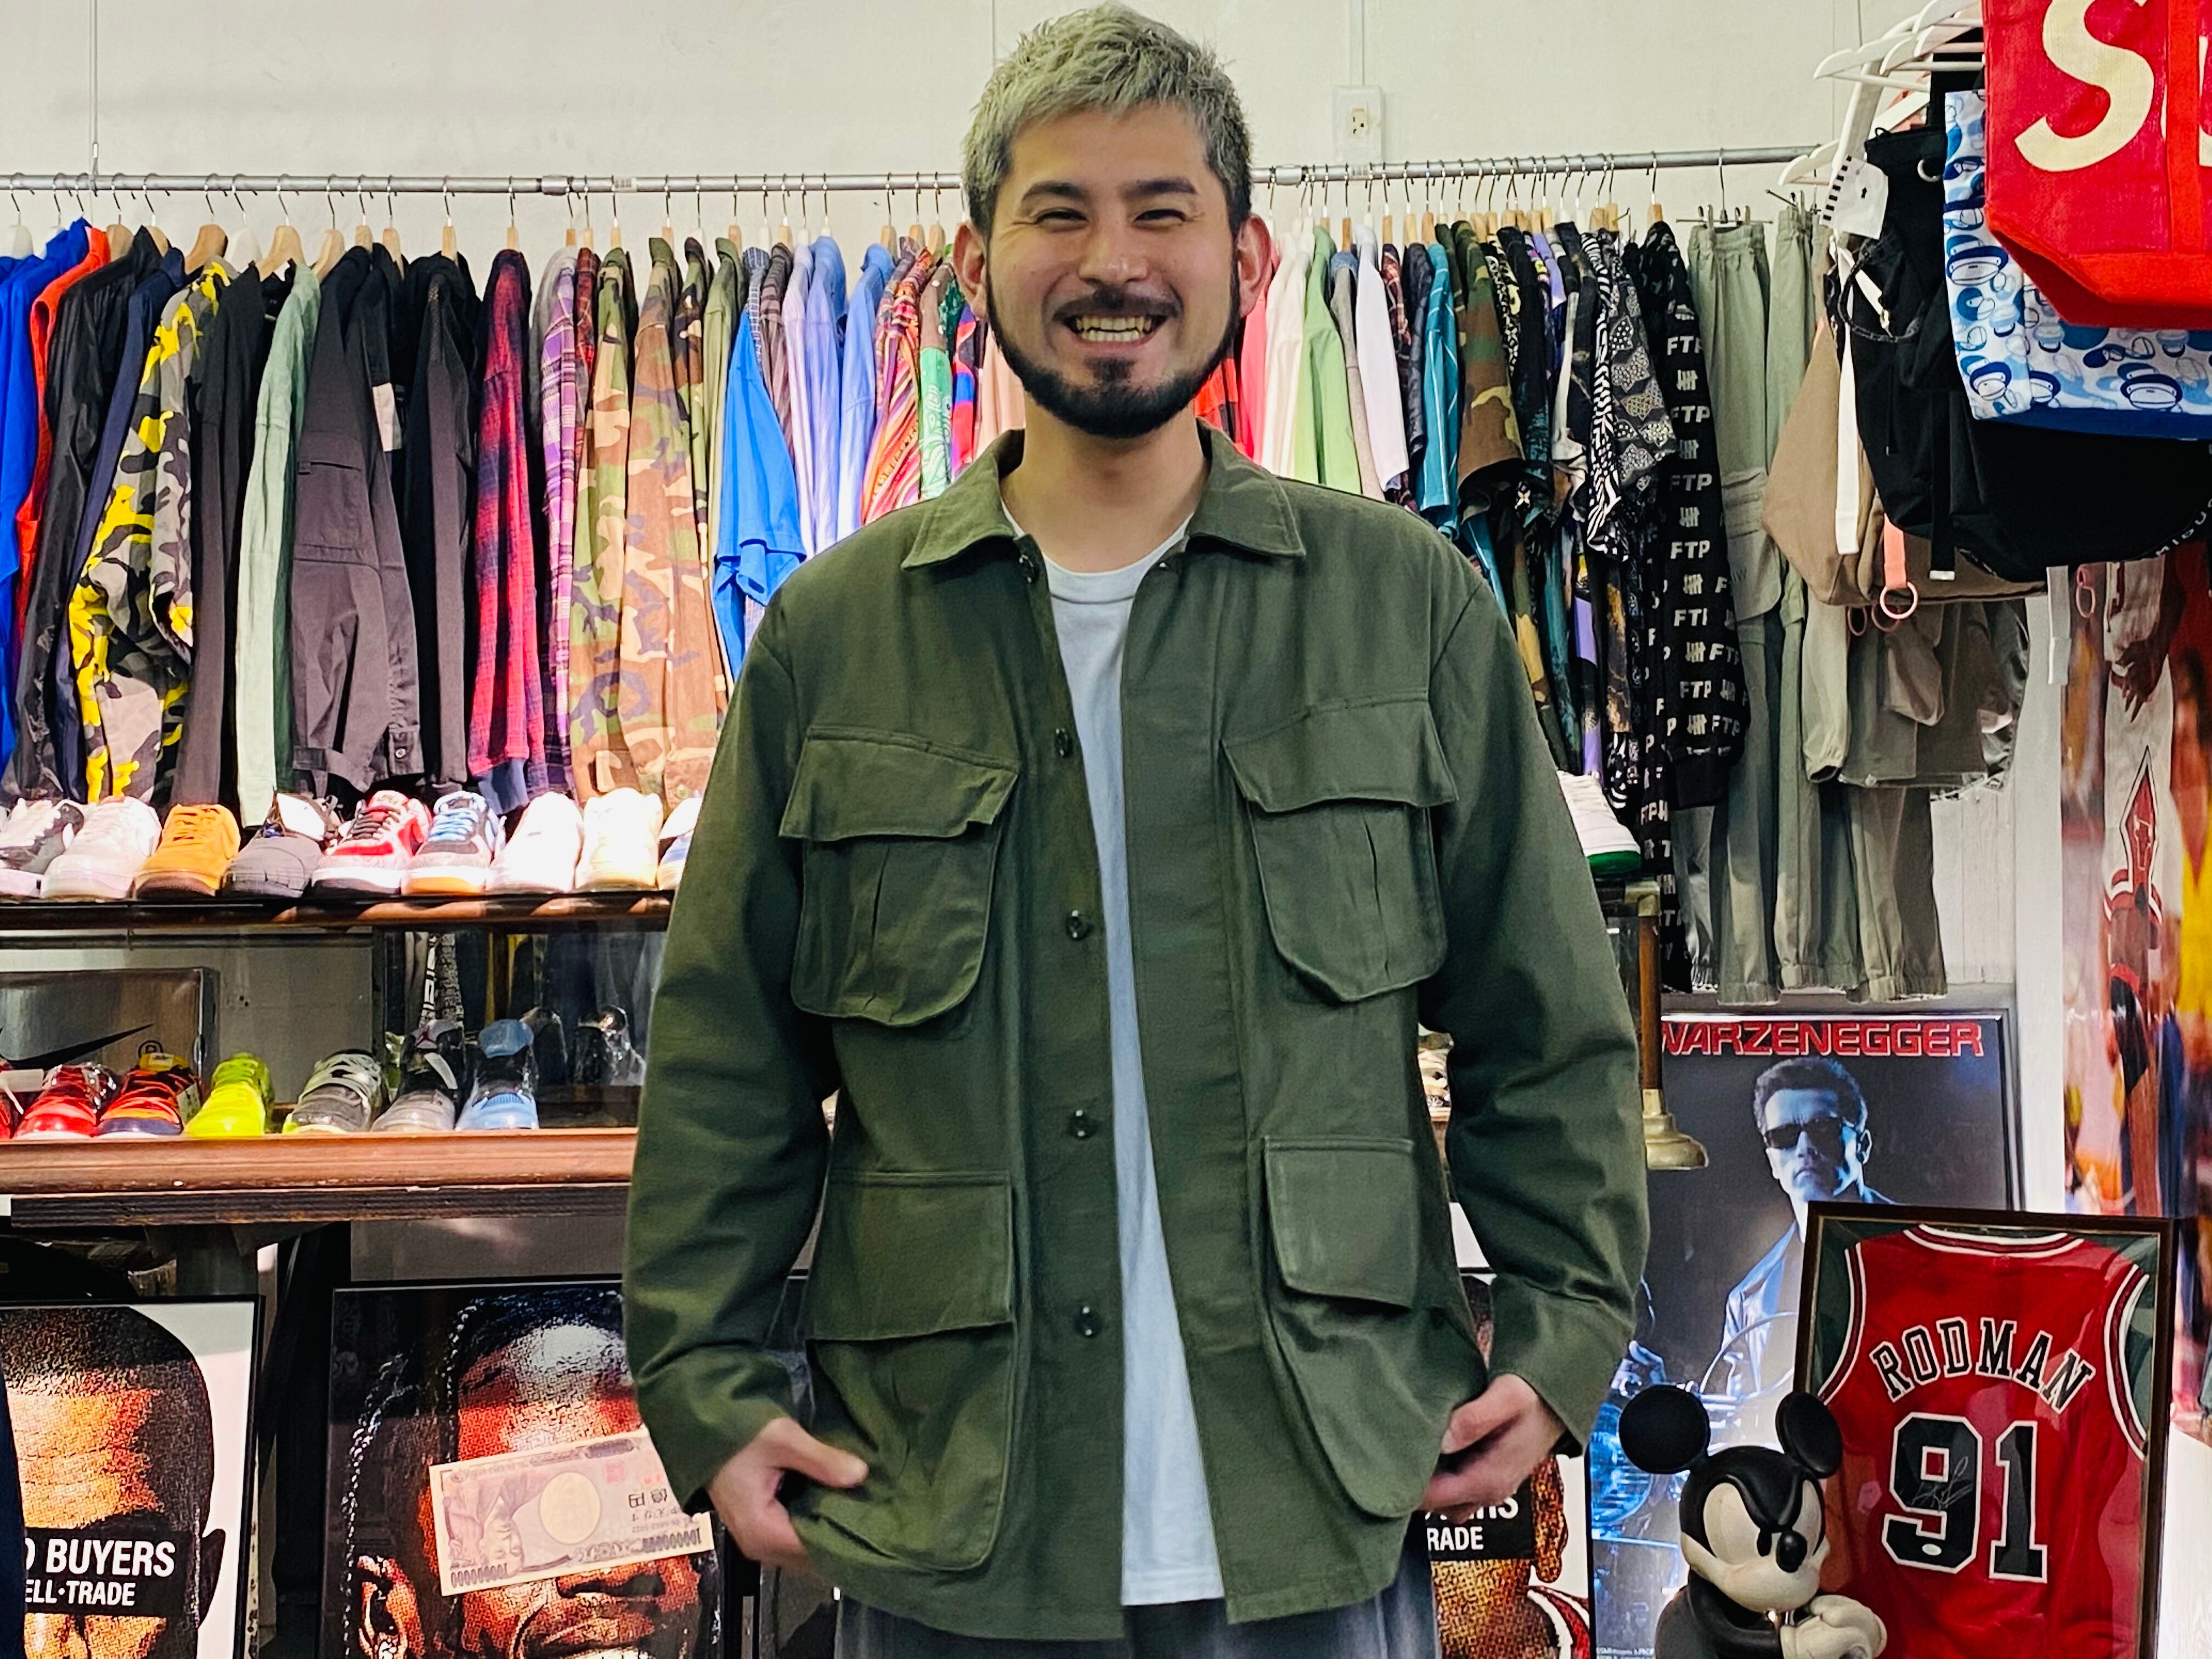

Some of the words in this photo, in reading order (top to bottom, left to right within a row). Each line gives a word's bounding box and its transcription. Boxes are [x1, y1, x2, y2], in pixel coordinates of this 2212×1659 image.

[1671, 540, 1710, 559] FTP
[1680, 680, 1711, 698] FTP
[1869, 1317, 2097, 1414] RODMAN
[1881, 1412, 2048, 1584] 91
[46, 1538, 176, 1577] BUYERS
